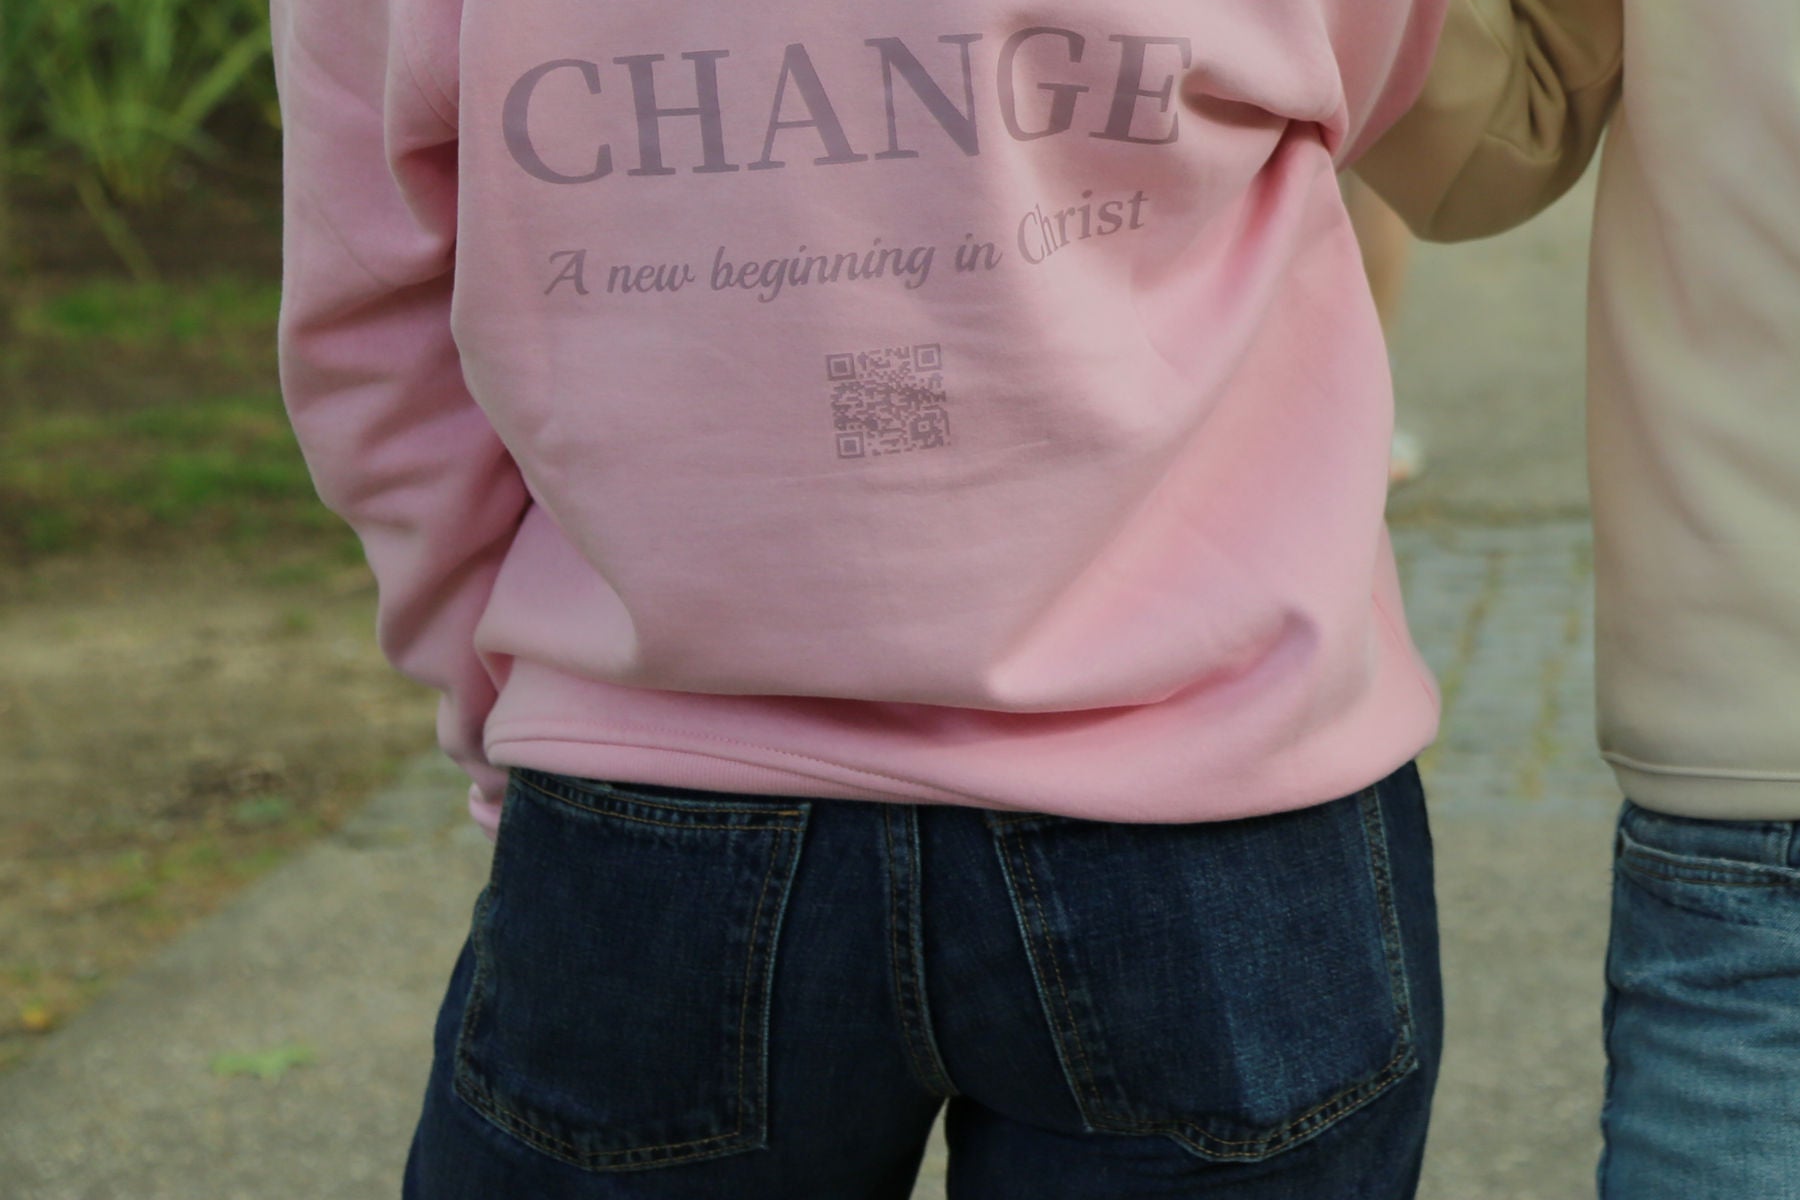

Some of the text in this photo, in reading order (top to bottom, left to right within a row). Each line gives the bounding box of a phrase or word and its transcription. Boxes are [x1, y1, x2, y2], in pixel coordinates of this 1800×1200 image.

[501, 25, 1194, 185] CHANGE
[543, 189, 1149, 304] A new beginning in Christ
